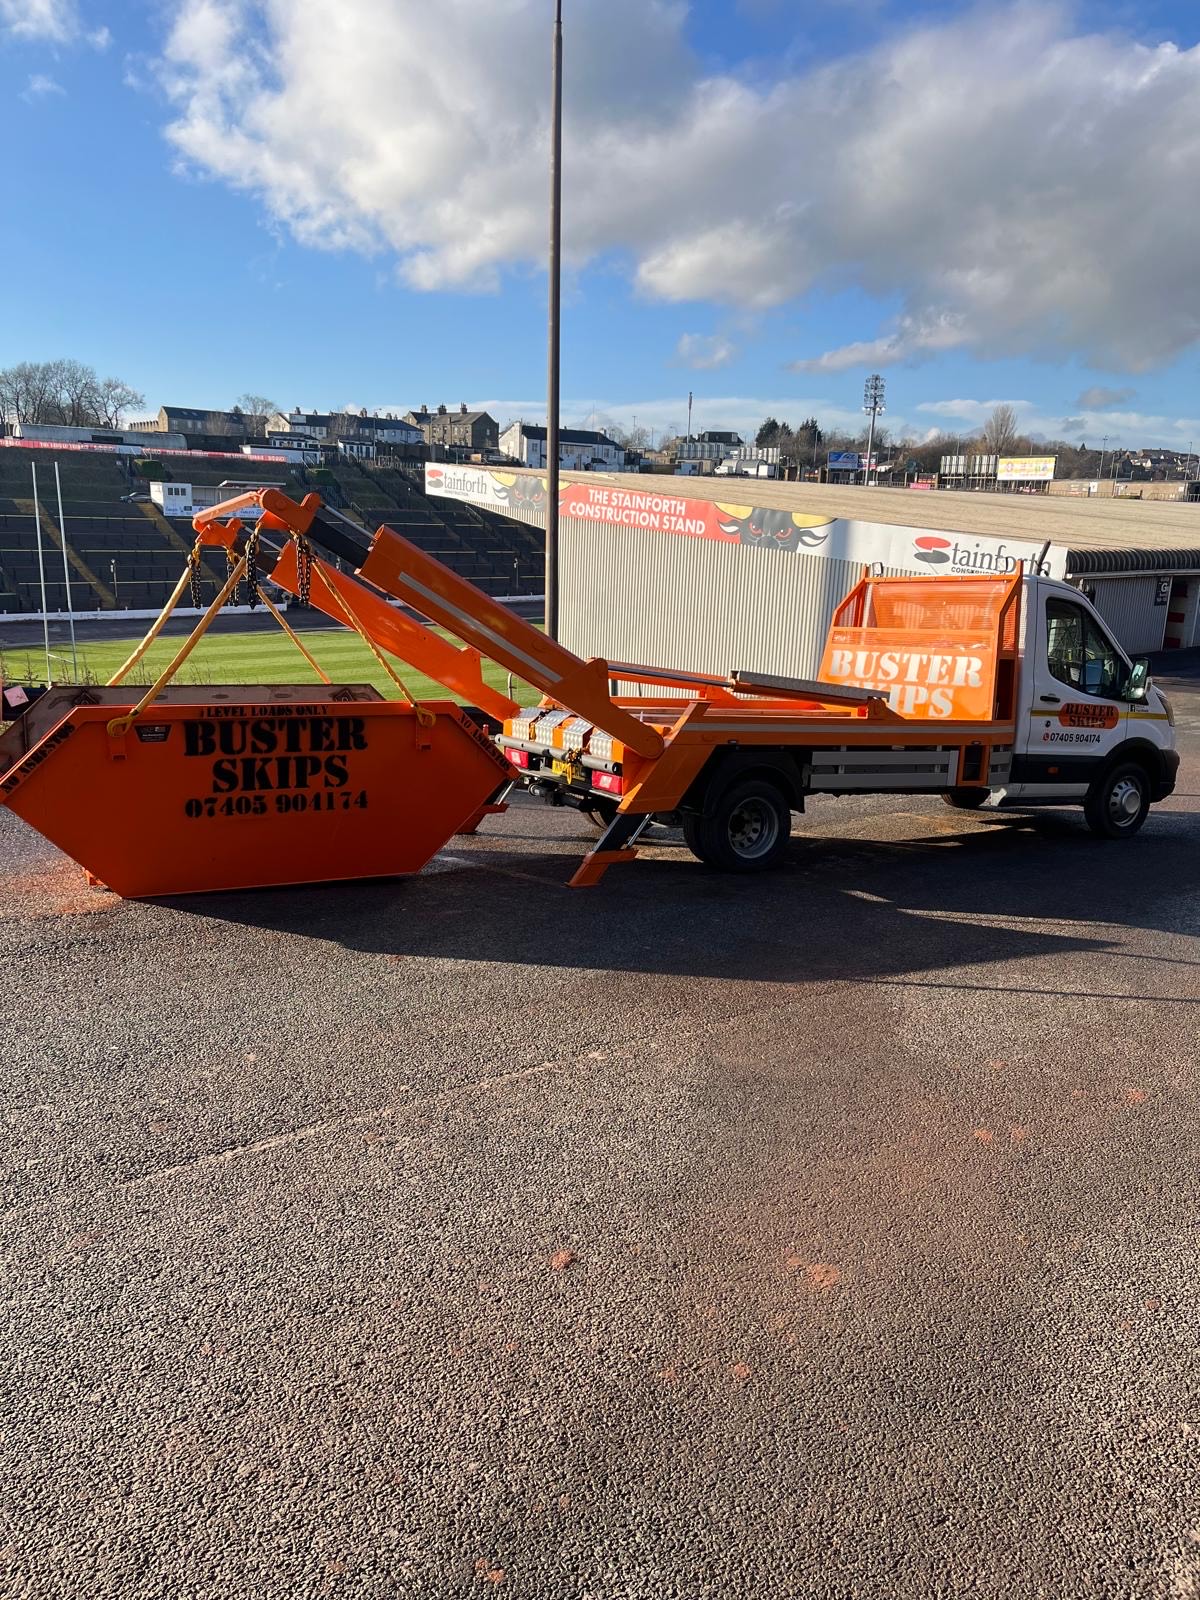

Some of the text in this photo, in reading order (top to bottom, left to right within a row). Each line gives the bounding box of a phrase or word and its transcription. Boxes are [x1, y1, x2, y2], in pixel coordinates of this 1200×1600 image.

[588, 489, 687, 516] THE STAINFORTH
[569, 502, 706, 535] CONSTRUCTION STAND
[829, 649, 983, 688] BUSTER
[207, 704, 329, 718] LEVEL LOADS ONLY
[841, 681, 955, 718] IPS
[1065, 703, 1114, 717] BUSTER
[459, 712, 472, 729] NO
[1069, 715, 1106, 728] SKIPS
[183, 718, 369, 757] BUSTER
[1050, 732, 1101, 743] 07405 904174
[212, 754, 349, 794] SKIPS
[185, 790, 368, 818] 07405 904174
